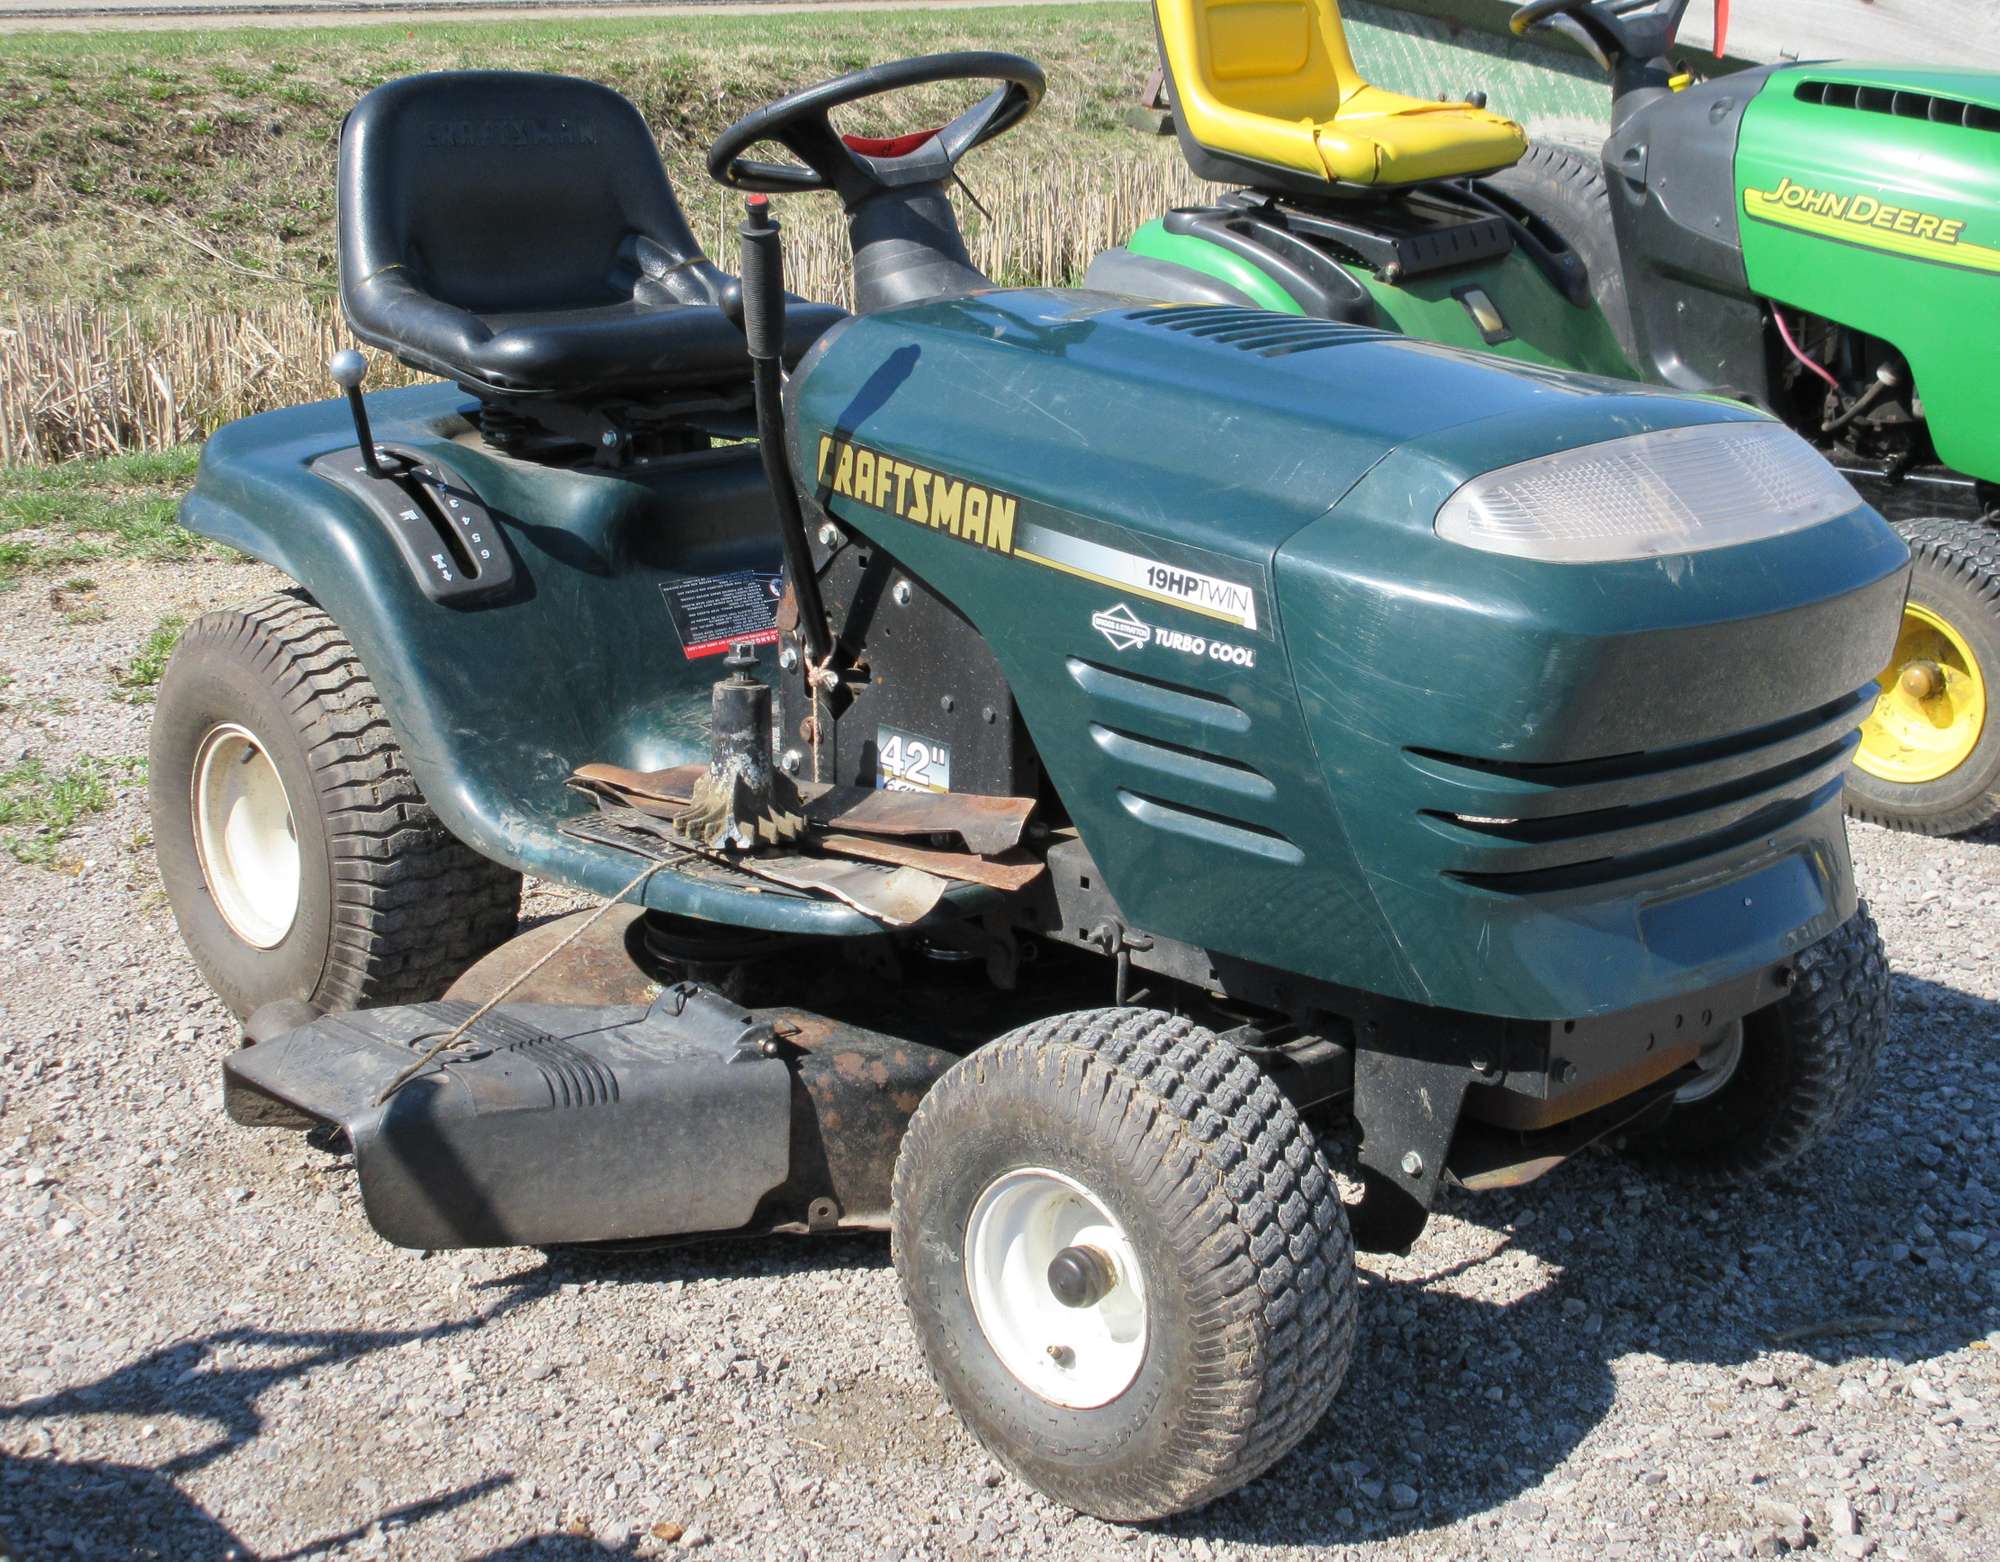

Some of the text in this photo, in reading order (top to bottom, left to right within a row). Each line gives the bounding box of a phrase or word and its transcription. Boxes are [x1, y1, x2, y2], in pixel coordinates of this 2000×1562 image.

[1763, 177, 1965, 244] JOHN DEERE
[817, 435, 1017, 554] CRAFTSMAN
[450, 499, 459, 508] 3
[461, 516, 471, 525] 4
[471, 533, 481, 543] 5
[480, 549, 490, 559] 6
[1155, 628, 1255, 668] TURBO COOL
[880, 735, 945, 786] 42"
